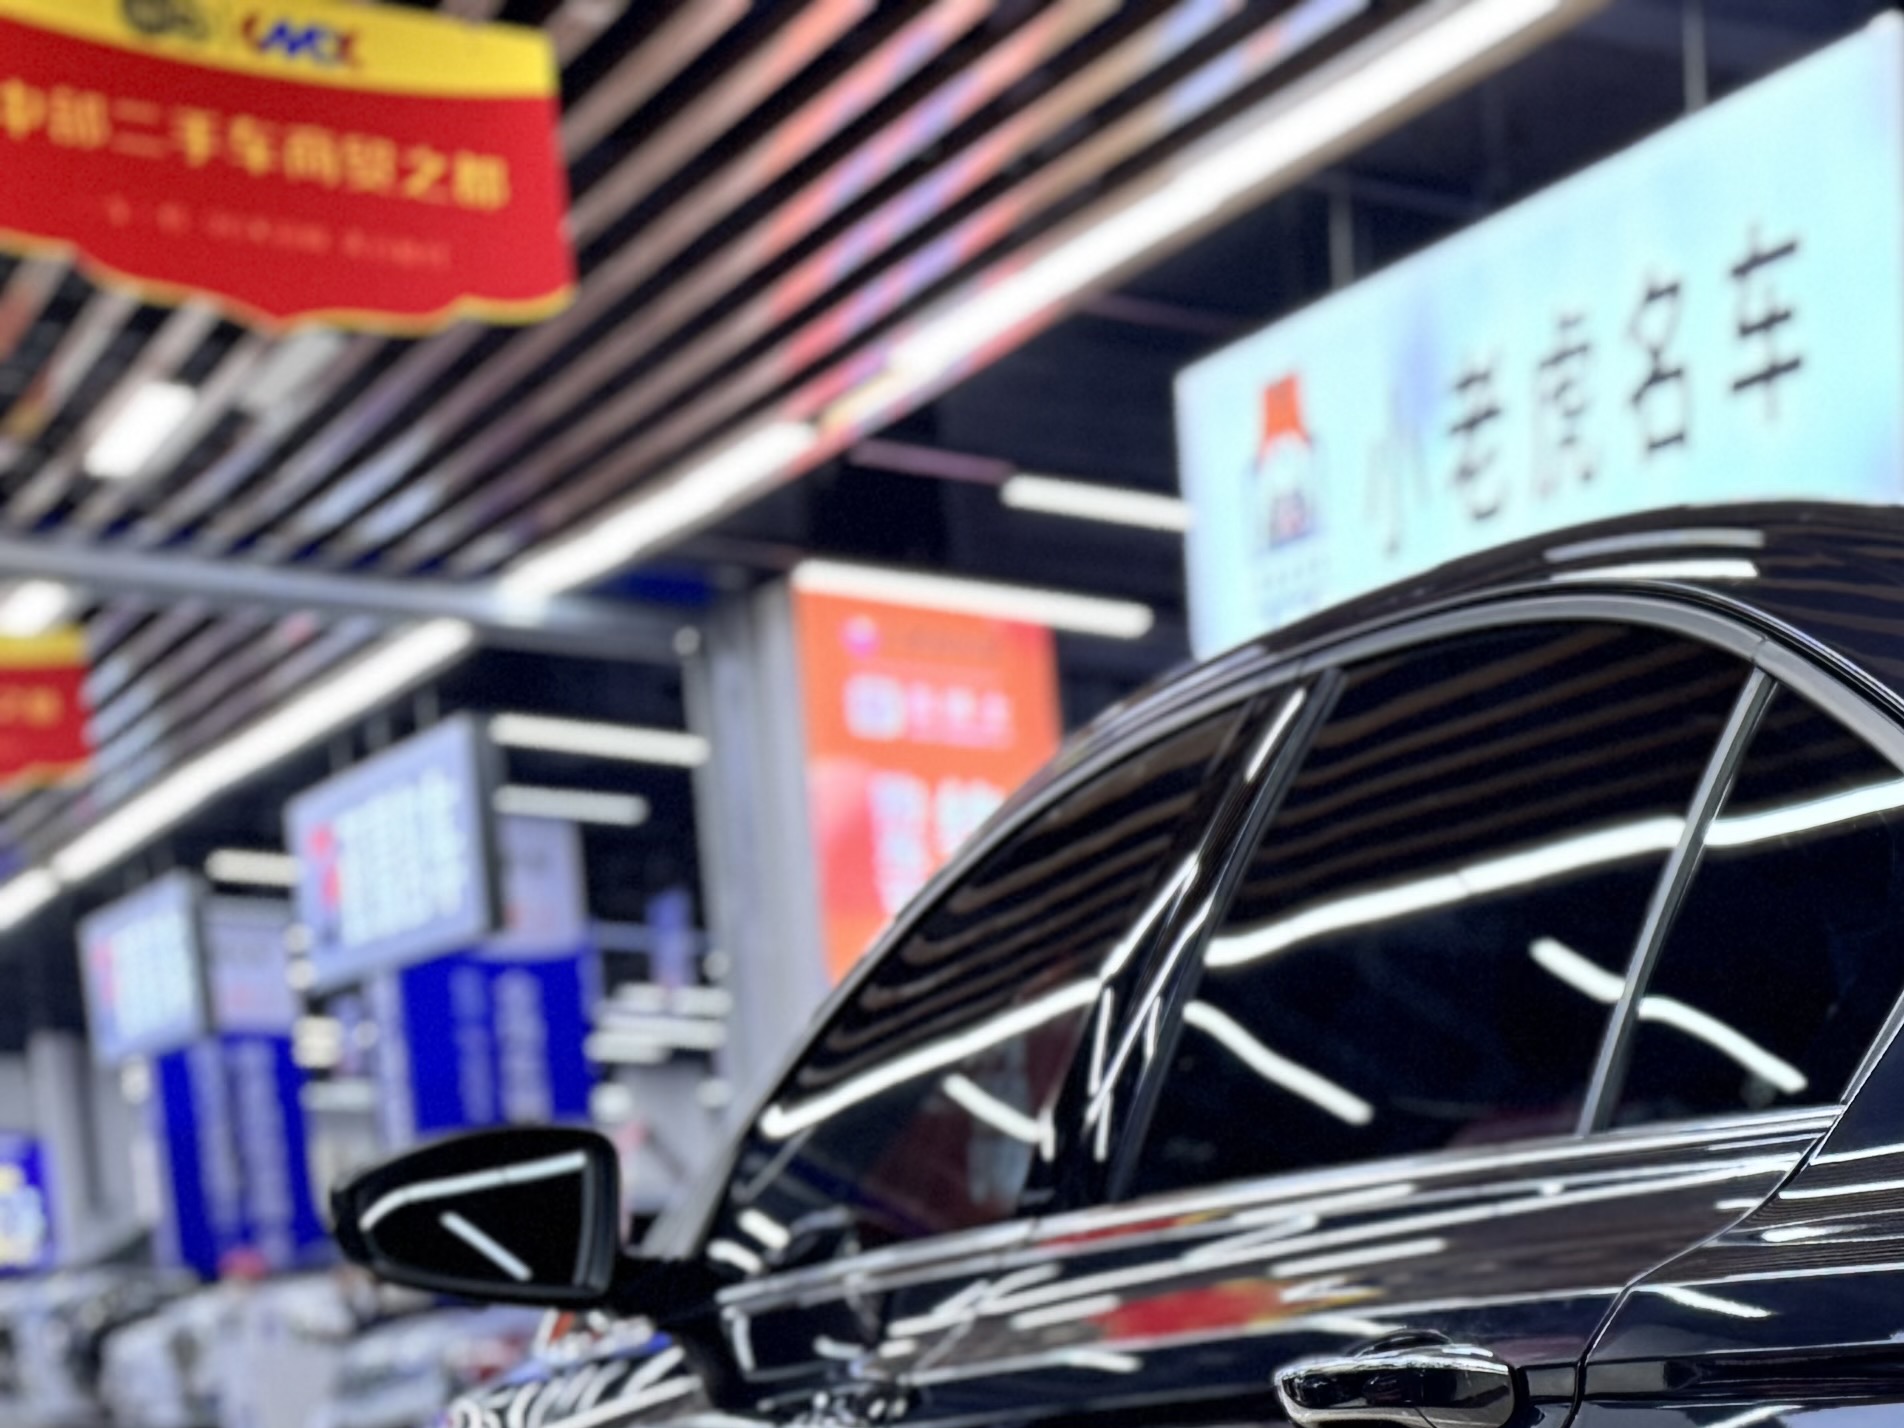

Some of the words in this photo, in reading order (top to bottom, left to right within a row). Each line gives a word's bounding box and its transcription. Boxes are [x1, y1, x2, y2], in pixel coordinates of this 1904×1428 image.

[1365, 225, 1804, 558] 小老虎名车
